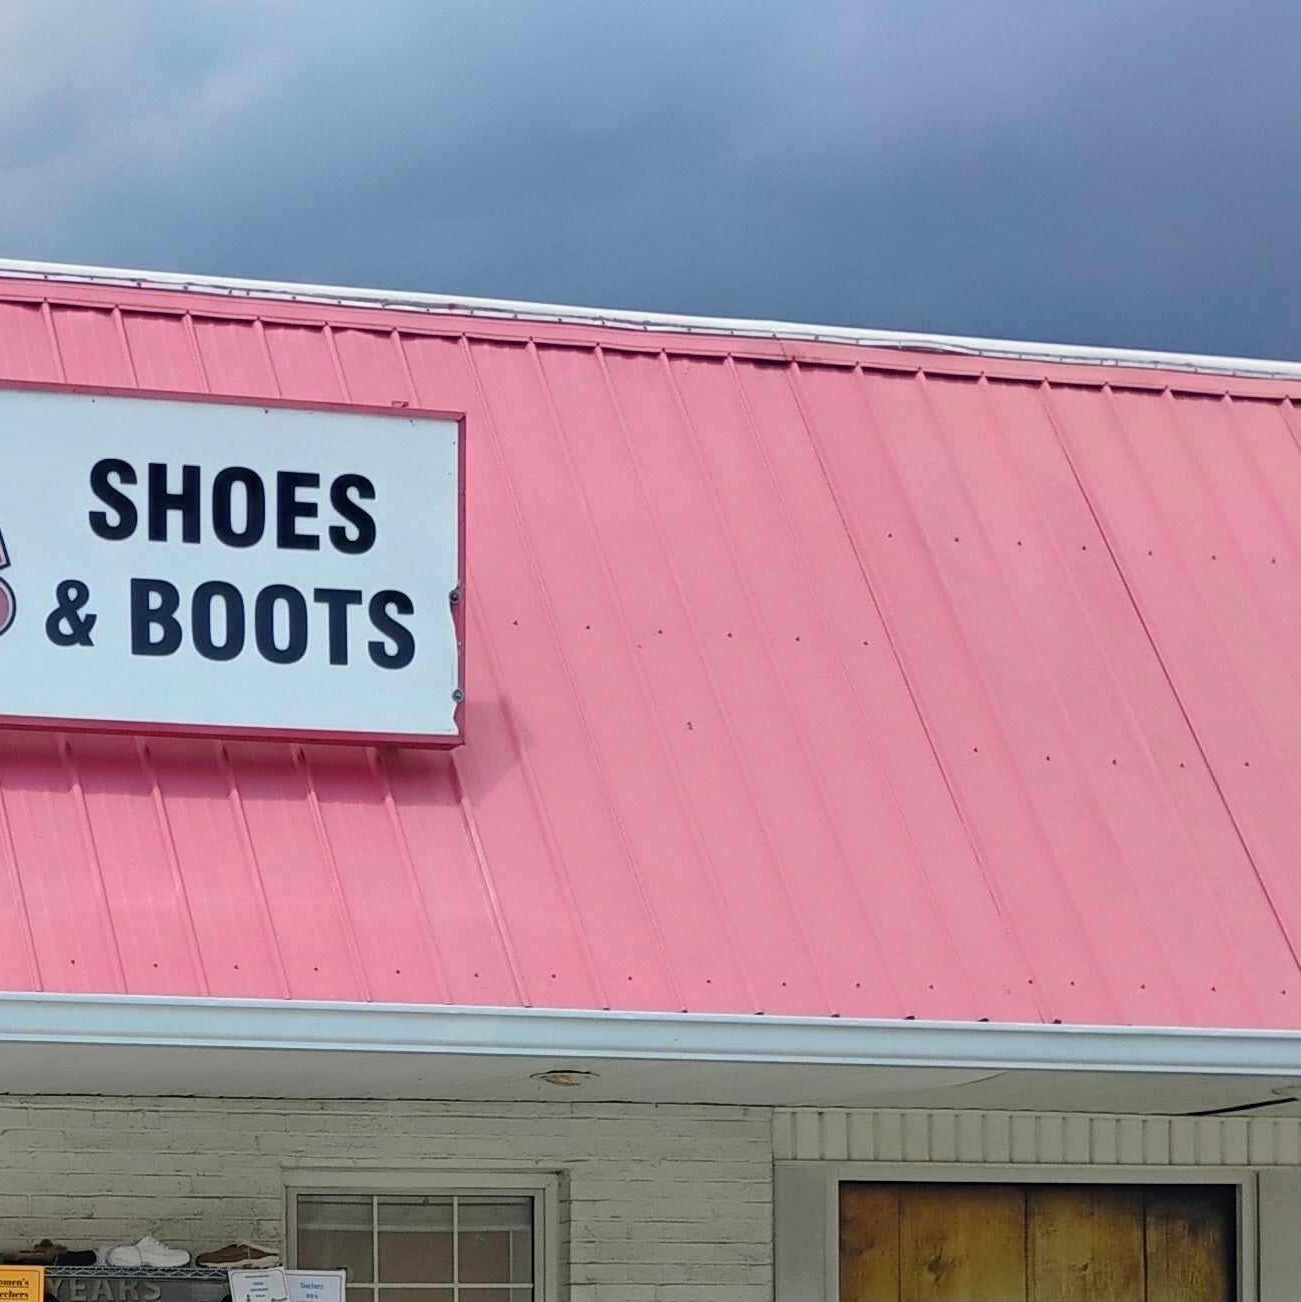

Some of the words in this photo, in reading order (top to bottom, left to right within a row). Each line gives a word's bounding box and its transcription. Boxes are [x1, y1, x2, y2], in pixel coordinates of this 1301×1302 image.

[89, 458, 376, 554] SHOES
[45, 579, 97, 648] &
[130, 577, 415, 669] BOOTS
[48, 1279, 162, 1301] YEARS
